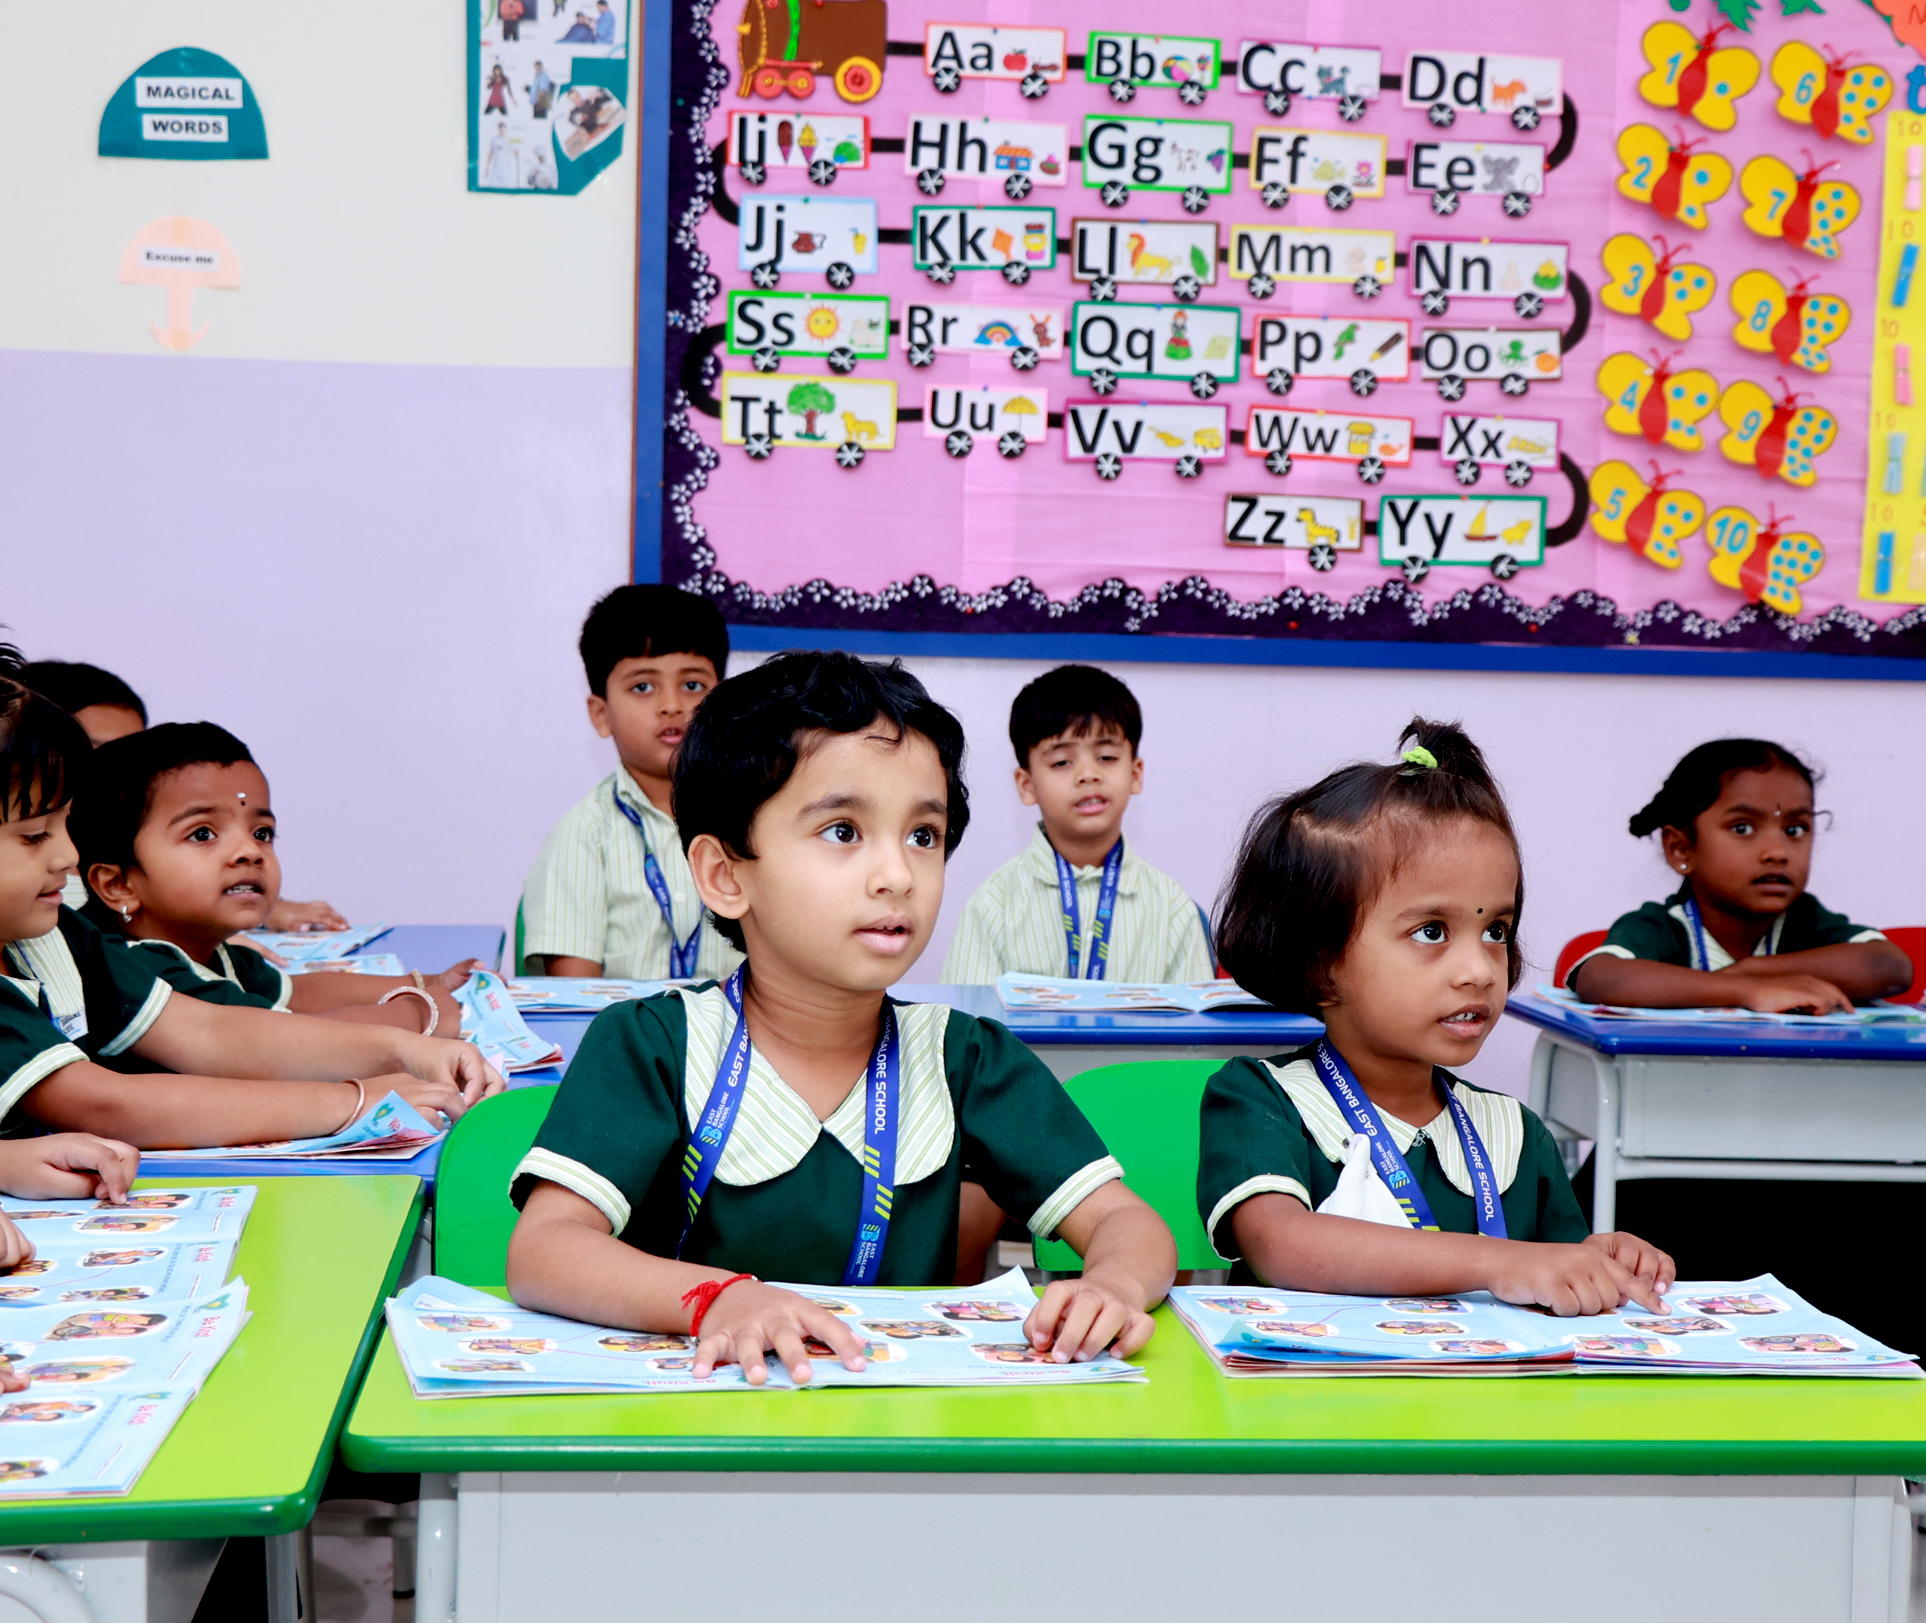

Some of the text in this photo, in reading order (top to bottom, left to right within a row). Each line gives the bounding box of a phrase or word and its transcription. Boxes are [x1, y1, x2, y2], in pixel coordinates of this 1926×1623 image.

[931, 31, 994, 72] Aa
[1095, 39, 1156, 80] Bb
[1241, 44, 1306, 95] Cc
[1666, 52, 1684, 84] 1
[146, 85, 235, 101] MAGICAL
[1408, 56, 1486, 106] Dd
[1795, 73, 1816, 105] 6
[152, 119, 224, 134] WORDS
[911, 121, 988, 173] Hh
[1088, 122, 1164, 184] Gg
[1255, 135, 1309, 185] Ff
[1412, 143, 1475, 191] Ee
[1633, 155, 1652, 189] 2
[1768, 188, 1788, 220] 7
[745, 205, 784, 266] Jj
[919, 212, 987, 263] Kk
[1079, 226, 1117, 276] Ll
[1237, 233, 1332, 274] Mm
[146, 251, 214, 264] Excuse me
[1414, 243, 1492, 292] Nn
[1622, 264, 1645, 297] 3
[735, 299, 796, 348] Ss
[907, 305, 959, 346] Rr
[1751, 300, 1772, 332] 8
[1080, 315, 1156, 372] Qq
[1259, 319, 1322, 373] Pp
[1423, 333, 1492, 372] Oo
[930, 390, 995, 432] Uu
[1620, 381, 1639, 414] 4
[730, 396, 783, 441] Tt
[1070, 408, 1144, 454] Vv
[1255, 414, 1340, 454] Ww
[1447, 417, 1504, 459] Xx
[1737, 409, 1762, 441] 9
[1228, 496, 1287, 544] Zz
[1603, 487, 1627, 520] 5
[1387, 501, 1453, 559] Yy
[1714, 516, 1748, 554] 10
[728, 1052, 745, 1088] EAST
[711, 1091, 730, 1127] BANGALORE
[875, 1081, 887, 1134] SCHOOL
[1319, 1049, 1378, 1137] EAST BANGALORE
[706, 1108, 717, 1125] EAST
[717, 1106, 730, 1129] SCHOOL
[1375, 1141, 1396, 1173] BANGALORE
[1380, 1161, 1391, 1175] EAST
[1386, 1149, 1399, 1171] SCHOOL
[1454, 1102, 1495, 1222] BANGALORE SCHOOL
[856, 1241, 867, 1265] SCHOOL
[857, 1242, 871, 1278] BANGALORE
[869, 1243, 877, 1259] EAST
